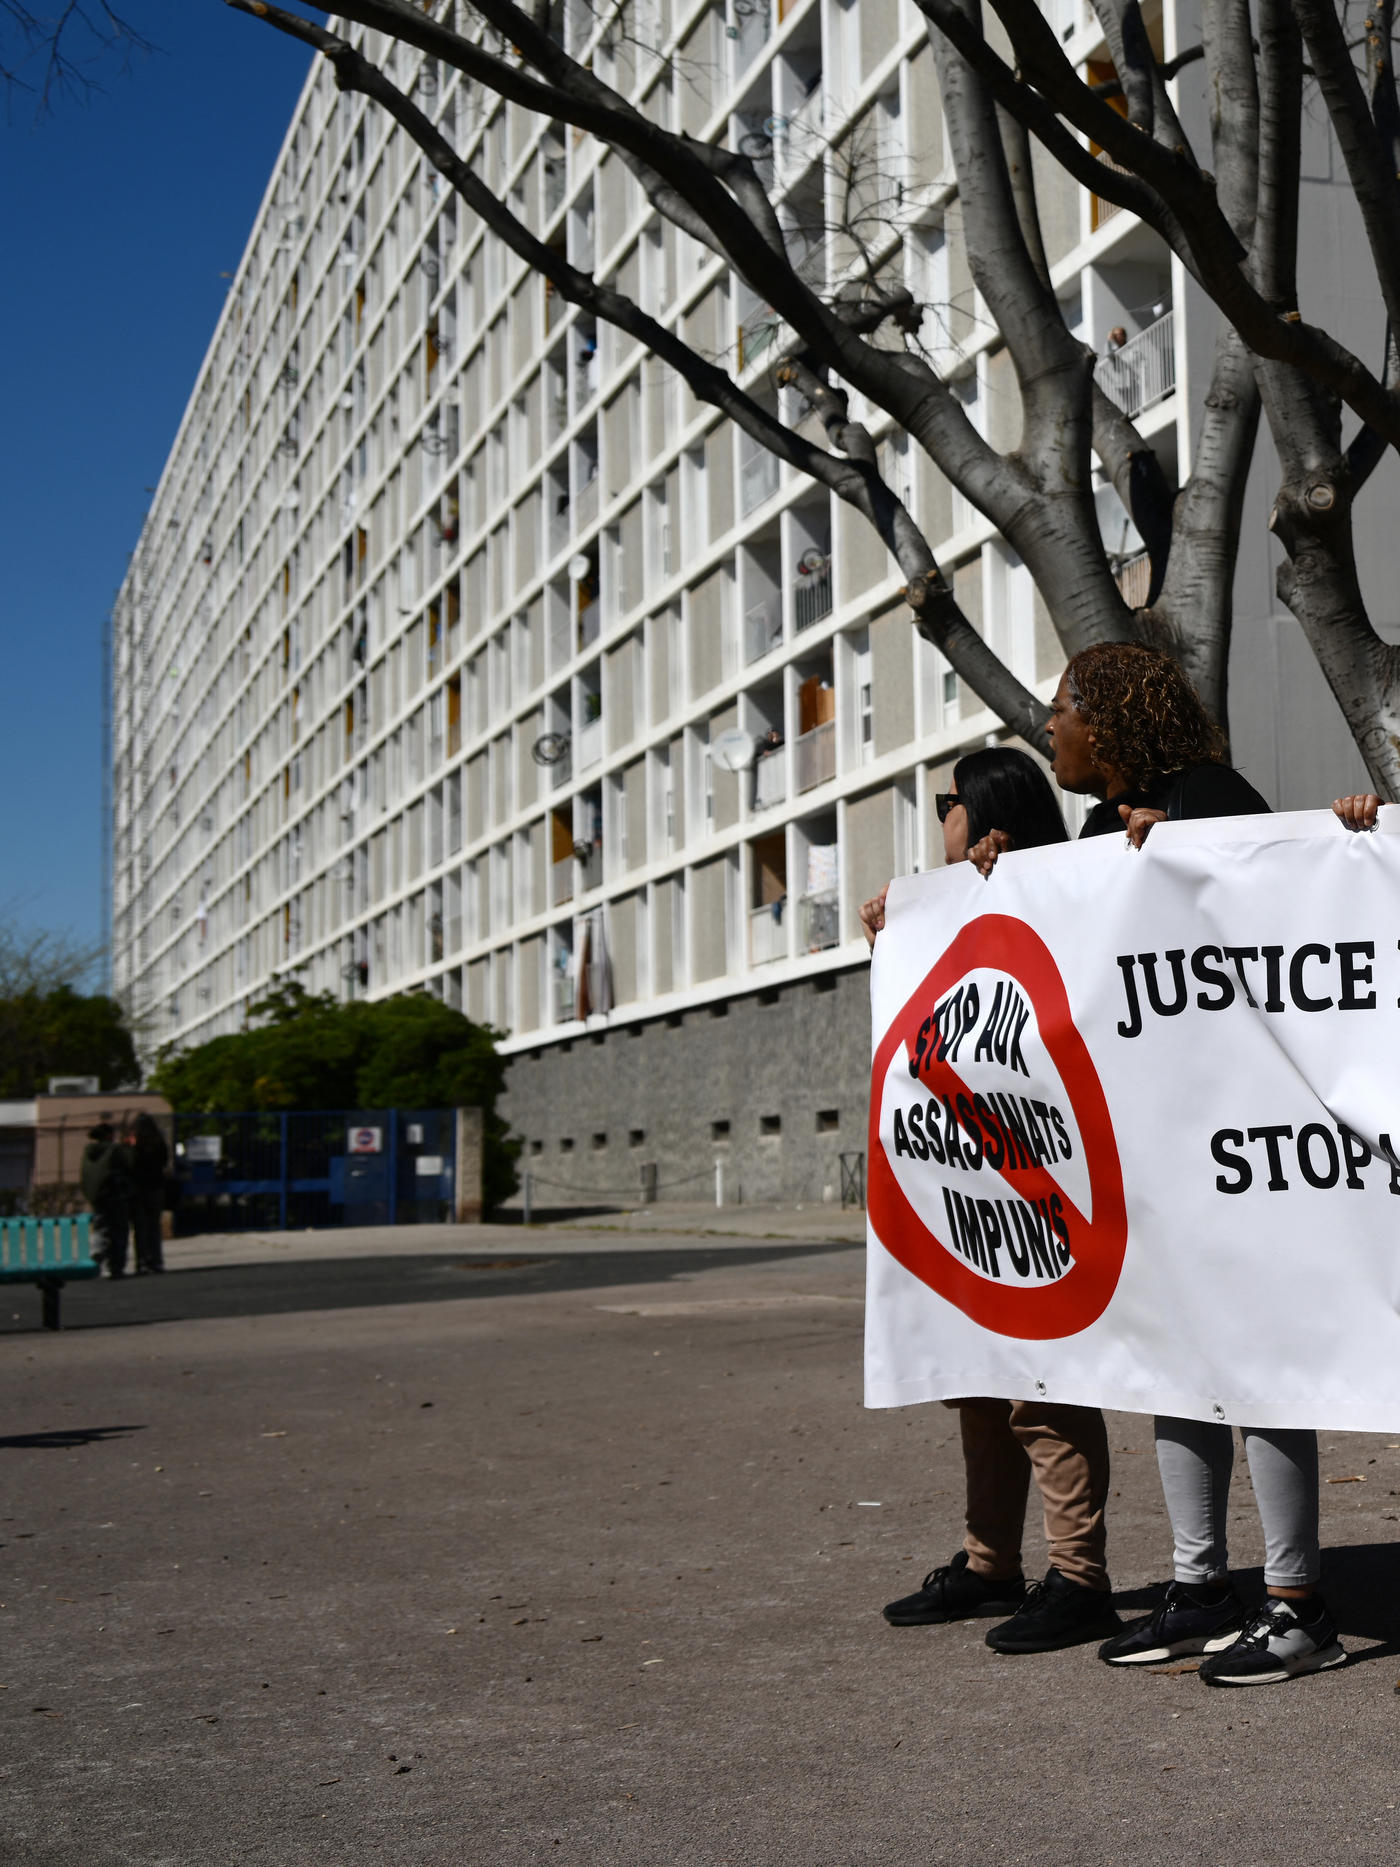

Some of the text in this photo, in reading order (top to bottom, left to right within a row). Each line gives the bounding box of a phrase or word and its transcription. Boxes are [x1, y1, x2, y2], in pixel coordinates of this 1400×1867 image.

[908, 980, 1030, 1079] STOP AUX
[1117, 938, 1377, 1039] JUSTICE
[894, 1092, 1073, 1171] ASSASSINATS
[1211, 1119, 1373, 1195] STOP
[941, 1186, 1071, 1279] IMPUNIS
